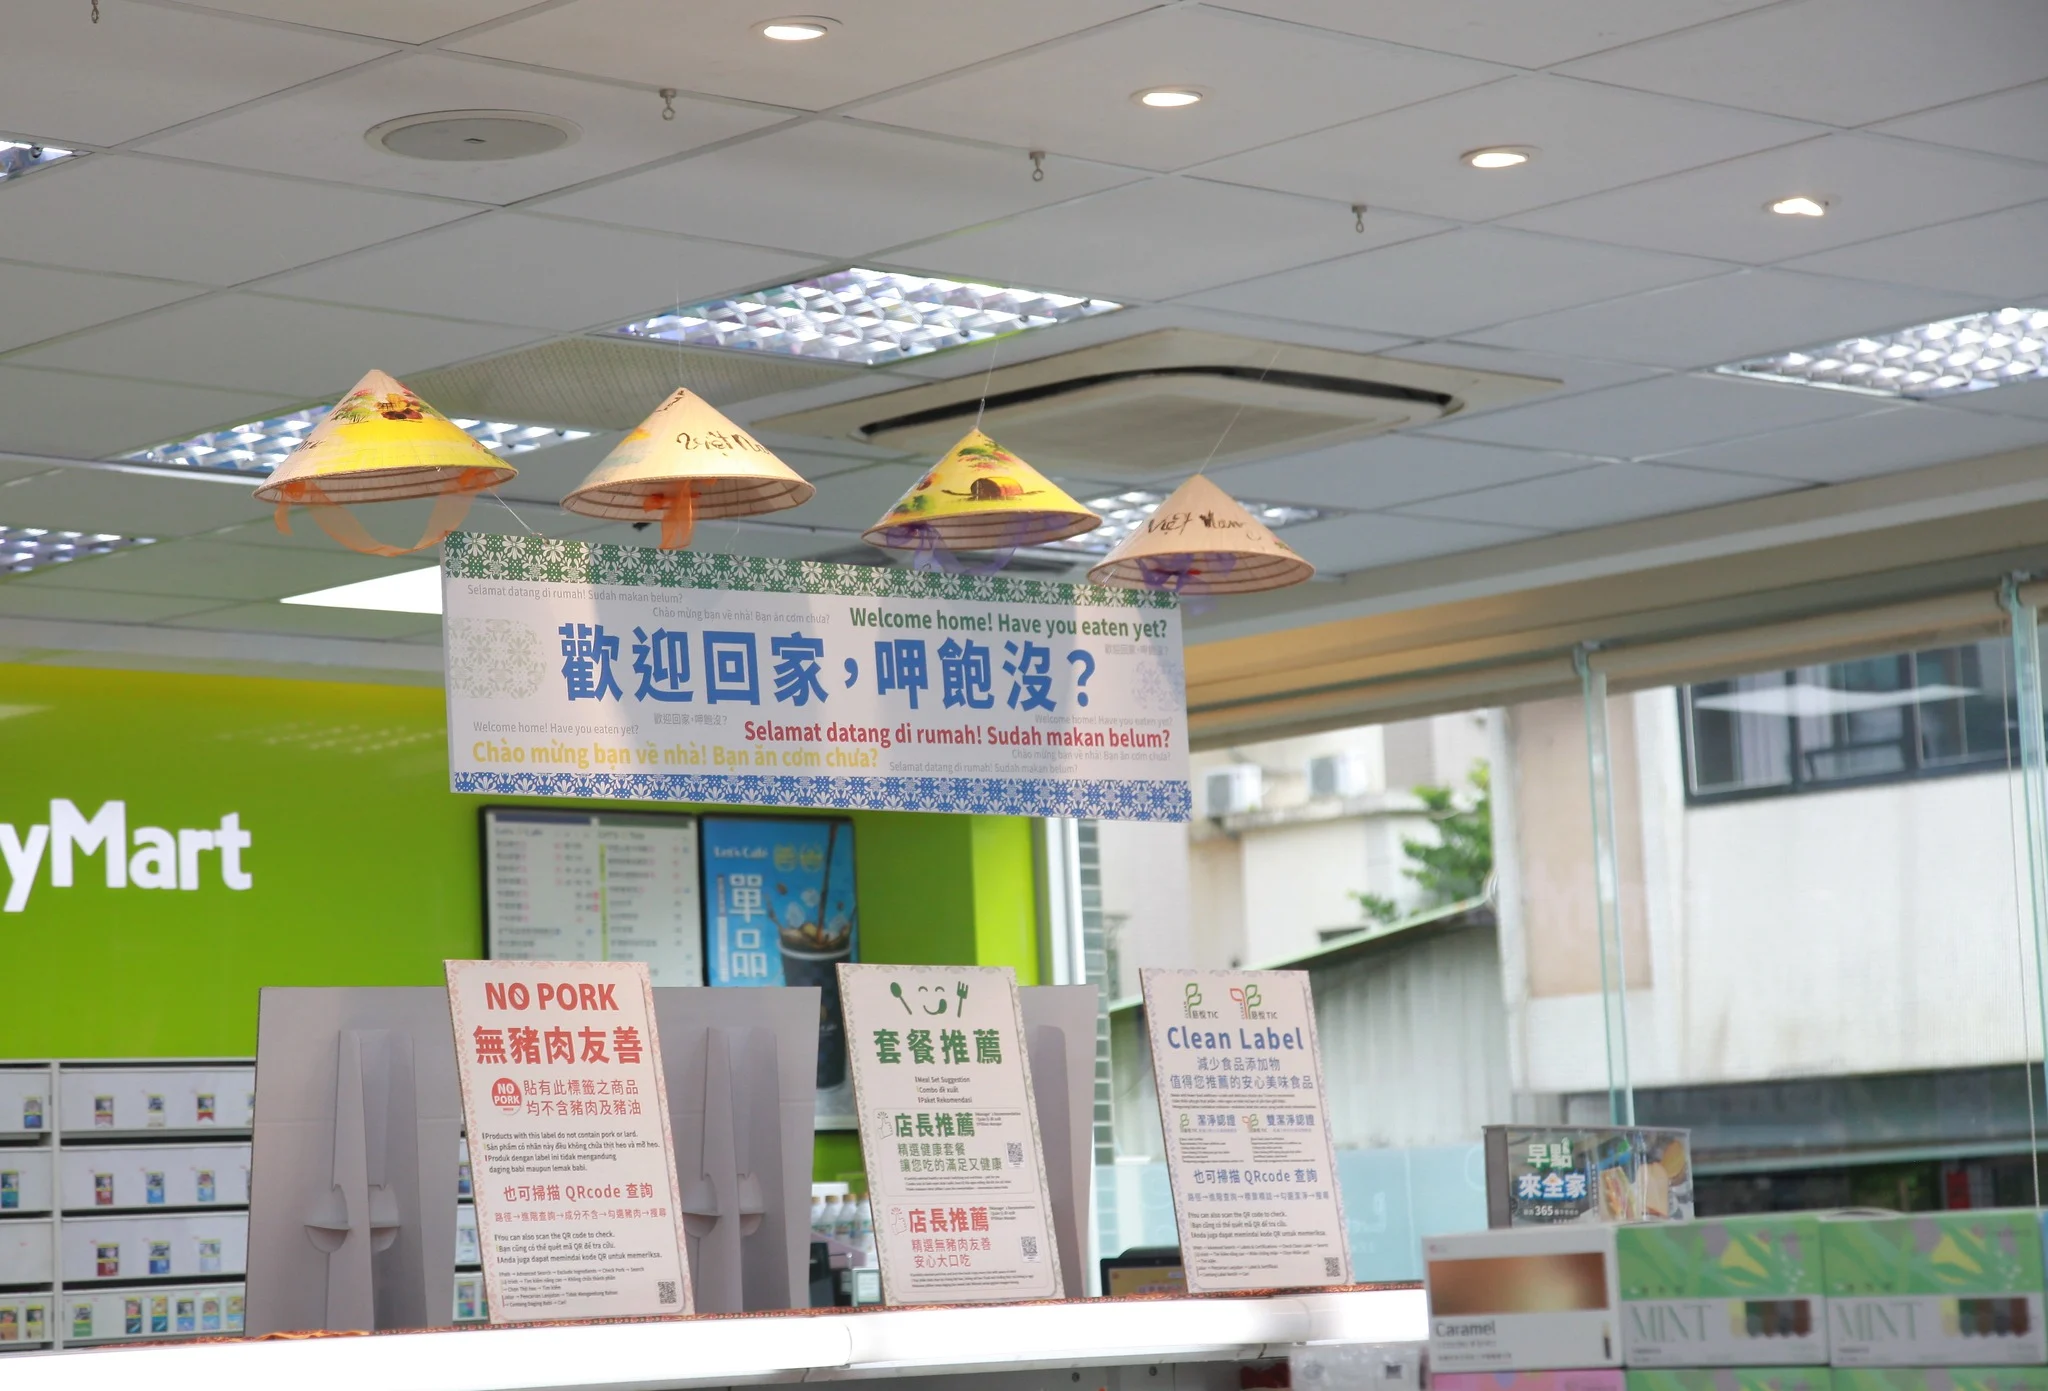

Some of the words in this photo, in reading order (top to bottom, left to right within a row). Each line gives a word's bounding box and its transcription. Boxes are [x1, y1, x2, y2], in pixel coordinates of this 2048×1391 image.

[467, 584, 506, 597] Selamat
[508, 585, 540, 600] datang
[542, 587, 551, 599] di
[553, 588, 586, 600] rumah!
[588, 589, 617, 601] Sudah
[618, 591, 649, 602] makan
[650, 593, 683, 604] belum?
[849, 606, 932, 630] Welcome
[937, 610, 993, 632] home!
[998, 613, 1041, 634] Have
[1045, 618, 1077, 639] you
[1082, 618, 1129, 637] eaten
[1133, 619, 1168, 642] yet?
[473, 721, 516, 734] Welcome
[518, 721, 548, 734] home!
[550, 723, 573, 735] Have
[575, 725, 592, 737] you
[594, 725, 618, 736] eaten
[619, 725, 639, 737] yet?
[744, 720, 822, 742] Selamat
[826, 722, 892, 749] datang
[895, 723, 912, 743] di
[917, 724, 982, 745] rumah!
[987, 725, 1042, 746] Sudah
[1047, 727, 1105, 747] makan
[1109, 727, 1171, 748] belum?
[472, 738, 526, 763] Chào
[530, 740, 590, 769] mừng
[594, 742, 631, 771] bạn
[635, 740, 659, 765] về
[664, 741, 706, 766] nhà!
[713, 745, 749, 772] Bạn
[755, 745, 778, 767] ăn
[782, 747, 821, 768] cơm
[826, 747, 879, 768] chưa?
[889, 761, 924, 773] Selamat
[925, 762, 953, 775] datang
[954, 762, 963, 773] di
[964, 763, 993, 773] rumah!
[995, 763, 1020, 773] Sudah
[1021, 764, 1048, 773] makan
[1050, 764, 1078, 774] belum?
[485, 982, 530, 1011] NO
[536, 983, 619, 1011] PORK
[473, 1025, 643, 1065] 無豬肉友善
[873, 1028, 1003, 1065] 套餐推薦
[1167, 1026, 1232, 1050] Clean
[1239, 1027, 1304, 1050] Label
[1196, 1056, 1281, 1071] 減少食品添加物
[497, 1083, 514, 1095] NO
[523, 1079, 639, 1096] 貼有此標籤之商品
[1169, 1074, 1314, 1090] 值得您推薦的安心美味食品
[494, 1095, 520, 1105] PORK
[526, 1100, 642, 1117] 均不含豬肉及豬油
[895, 1112, 975, 1138] 店長推薦
[485, 1132, 513, 1140] Products
[541, 1131, 556, 1139] label
[557, 1131, 566, 1139] do
[577, 1131, 600, 1139] contain
[601, 1131, 615, 1139] pork
[624, 1130, 638, 1138] lard.
[488, 1154, 510, 1162] Produk
[511, 1154, 534, 1163] dengan
[577, 1153, 617, 1161] mengandung
[897, 1142, 966, 1157] 精選健康套餐
[489, 1166, 511, 1174] daging
[511, 1165, 525, 1173] babi
[552, 1164, 571, 1172] lemak
[899, 1157, 1003, 1172] 讓您吃的滿足又健康
[1193, 1169, 1241, 1184] 也可掃描
[1244, 1169, 1291, 1185] QRcode
[1294, 1168, 1318, 1183] 查詢
[503, 1184, 561, 1202] 也可掃描
[565, 1184, 621, 1202] QRcode
[625, 1182, 654, 1199] 查詢
[1518, 1172, 1587, 1199] 來全家
[908, 1206, 989, 1234] 店長推薦
[562, 1232, 571, 1240] QR
[595, 1230, 615, 1238] check.
[911, 1237, 992, 1253] 精選無豬肉友善
[914, 1253, 972, 1269] 安心大口吃
[1435, 1320, 1496, 1338] Caramel
